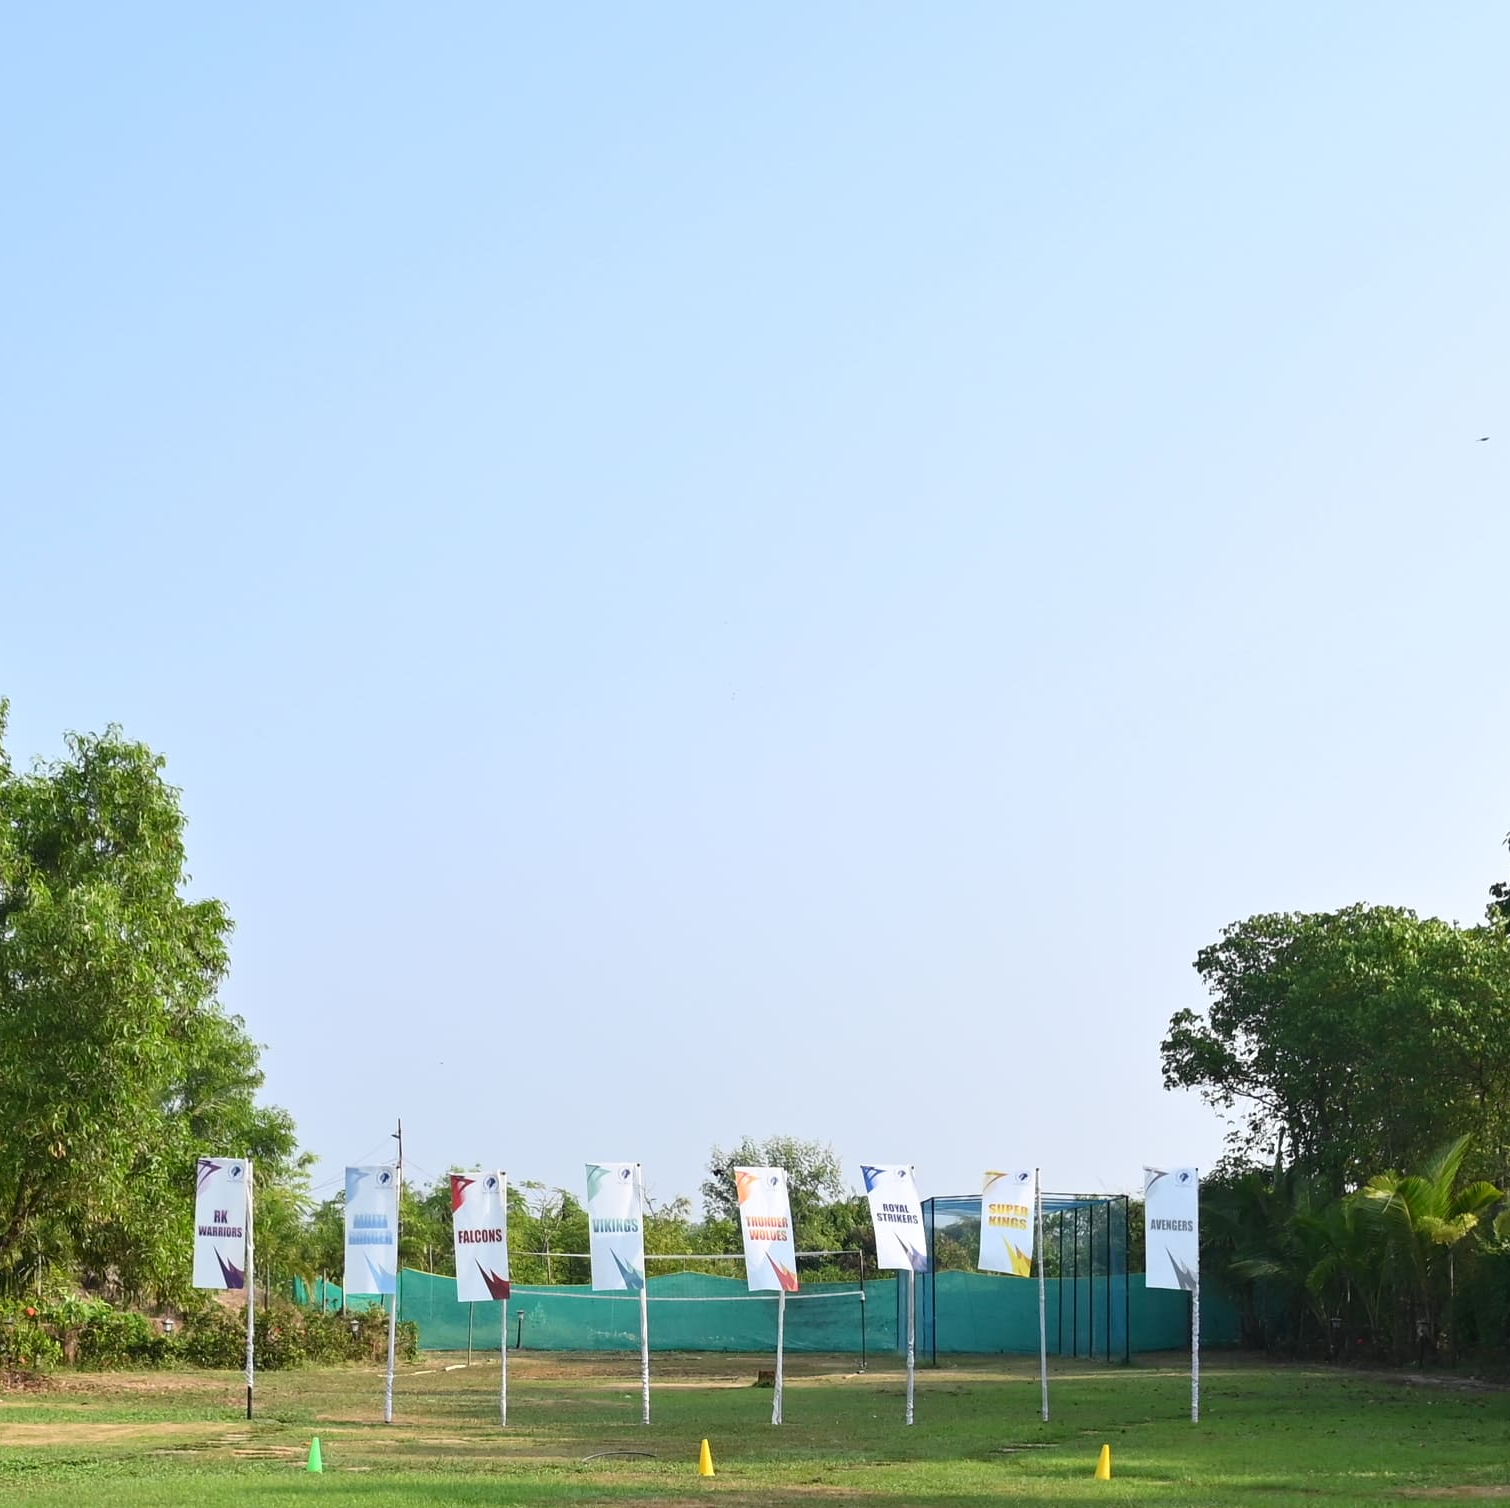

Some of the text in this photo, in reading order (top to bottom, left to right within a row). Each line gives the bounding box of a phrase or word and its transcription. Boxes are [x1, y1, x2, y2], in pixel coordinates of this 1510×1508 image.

[882, 1203, 910, 1213] ROYAL
[988, 1203, 1029, 1217] SUPER
[213, 1210, 228, 1224] RK
[746, 1216, 789, 1229] THUNDER
[876, 1212, 919, 1225] STRIKERS
[988, 1215, 1028, 1231] KINGS
[198, 1225, 243, 1239] WARRIORS
[593, 1219, 639, 1233] VIKINGS
[1150, 1219, 1194, 1232] AVENGERS
[458, 1229, 503, 1244] FALCONS
